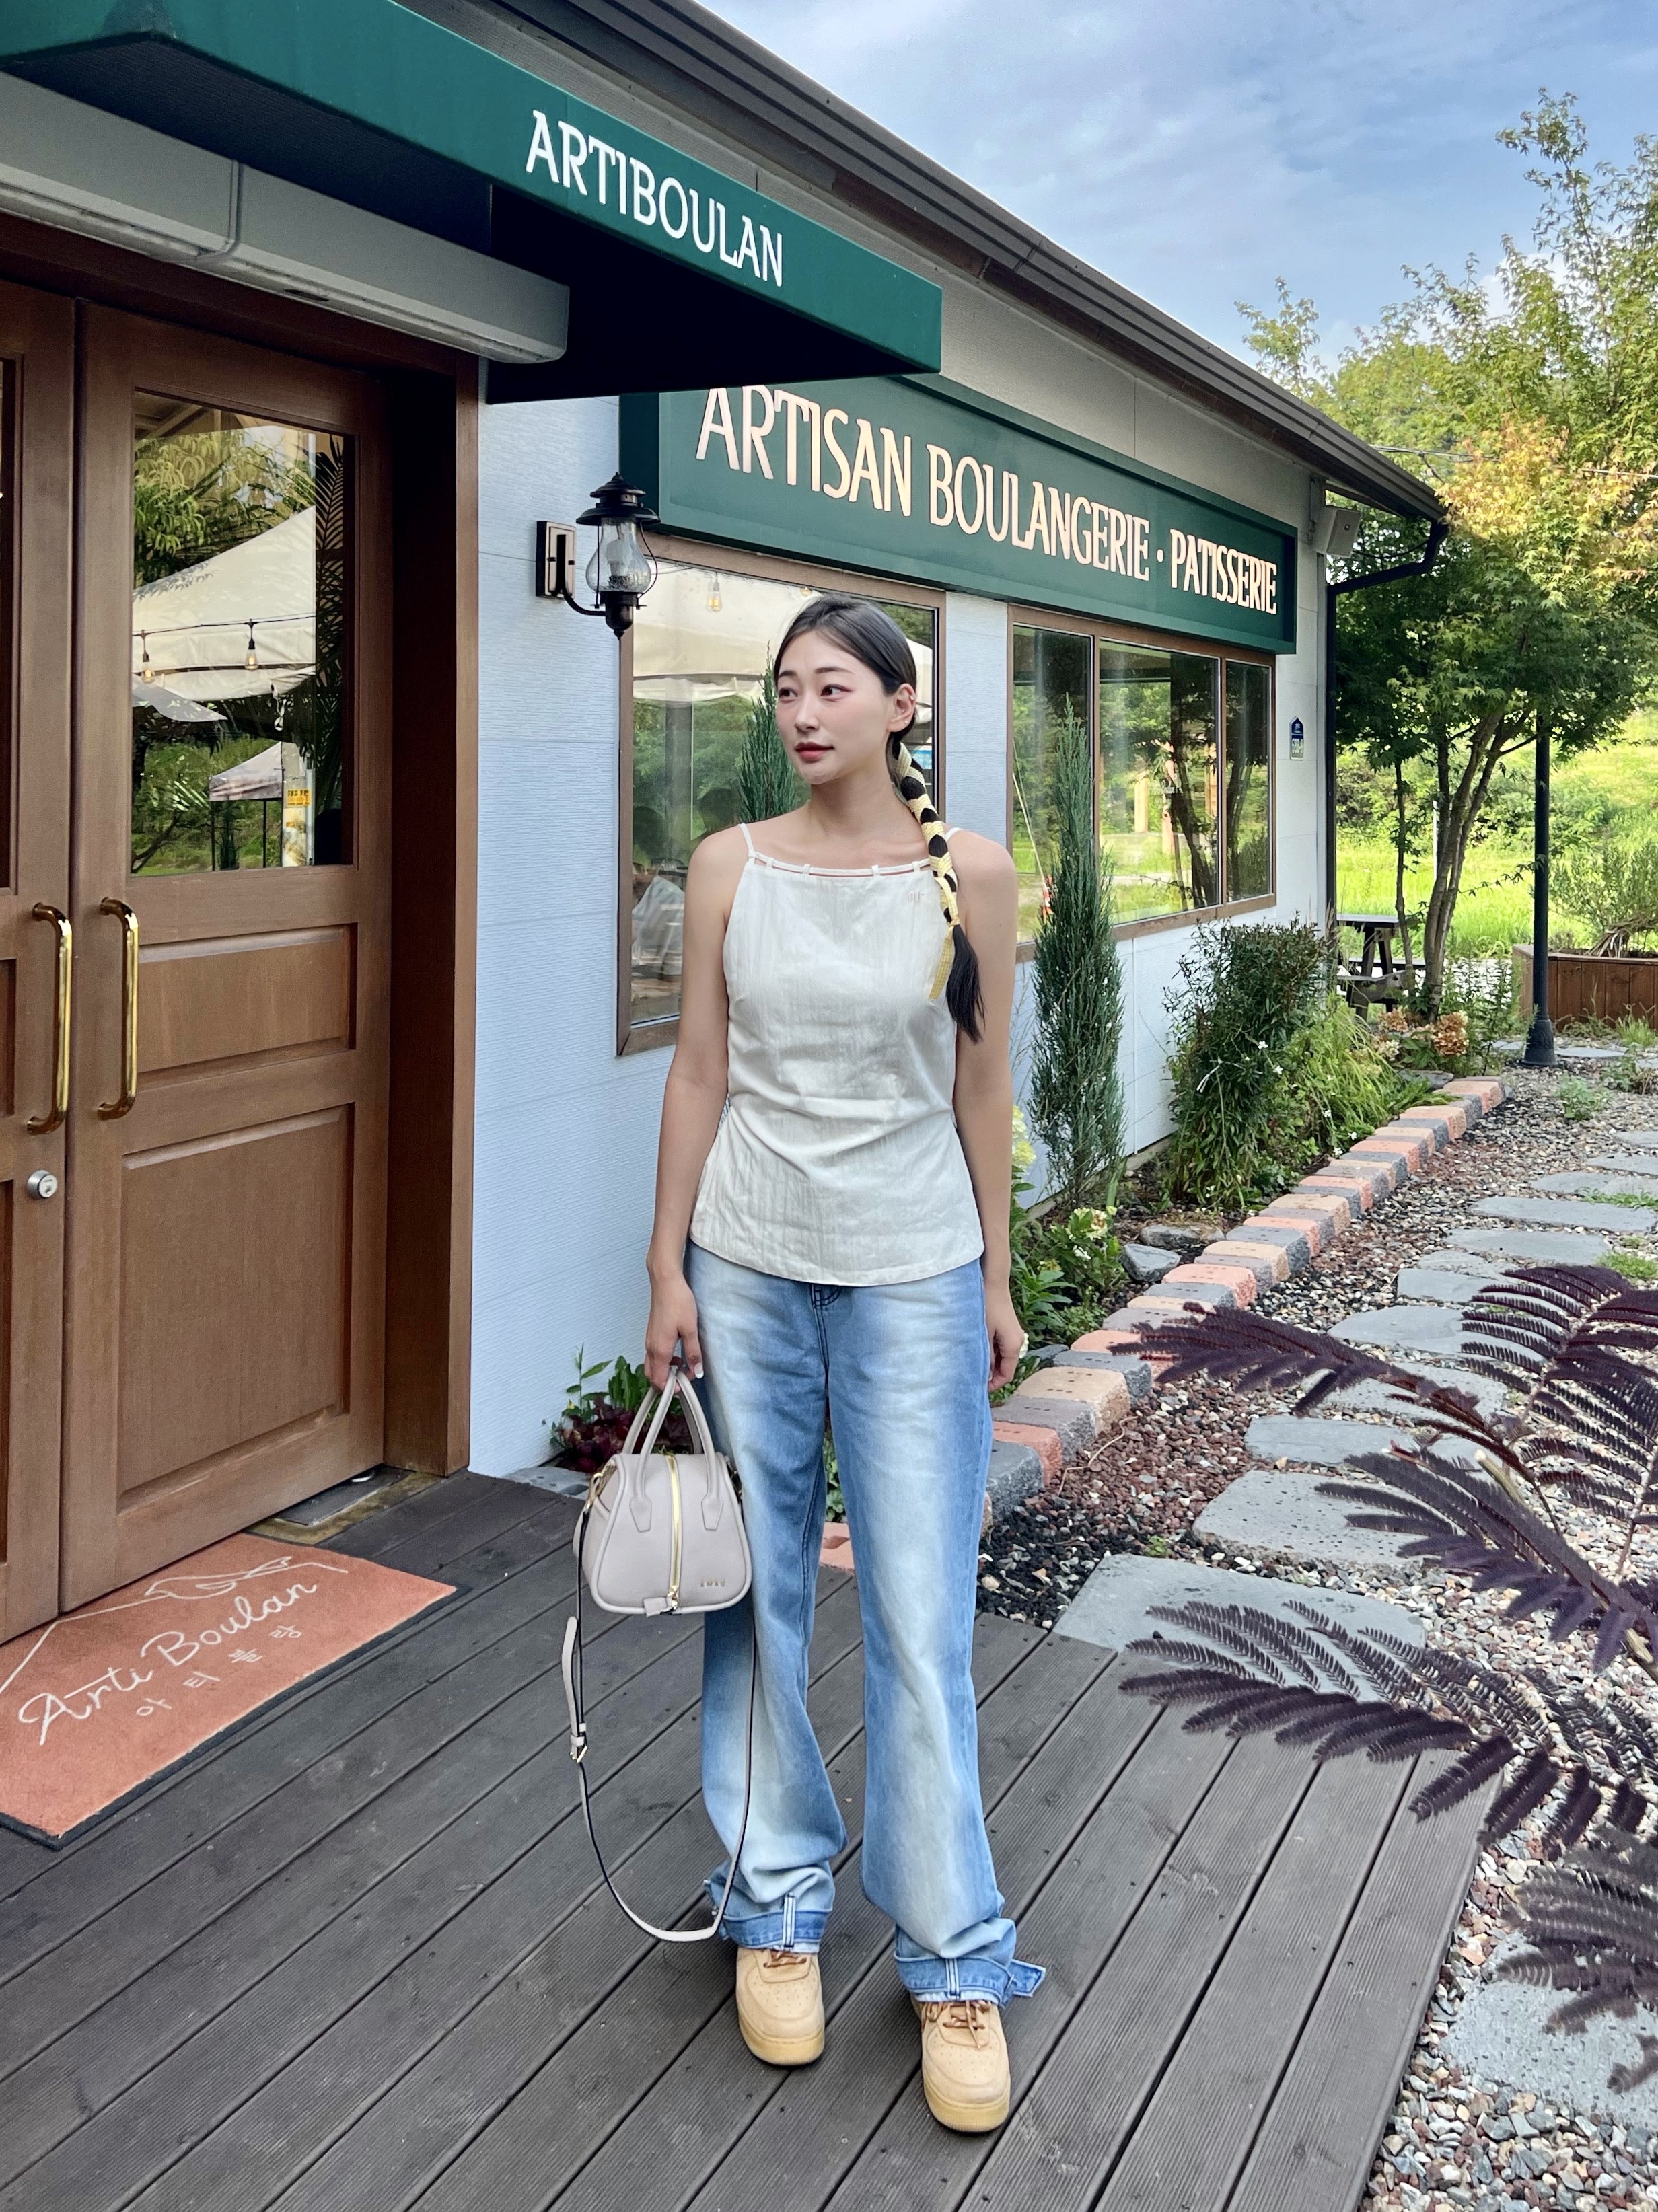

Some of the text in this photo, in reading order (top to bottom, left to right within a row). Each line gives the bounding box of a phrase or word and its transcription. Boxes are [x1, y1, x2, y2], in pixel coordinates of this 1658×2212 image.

[526, 109, 783, 287] ARTIBOULAN
[696, 385, 1278, 615] ARTISAN BOULANGERIE PATISSERIE
[17, 1583, 318, 1746] Arti Boulan
